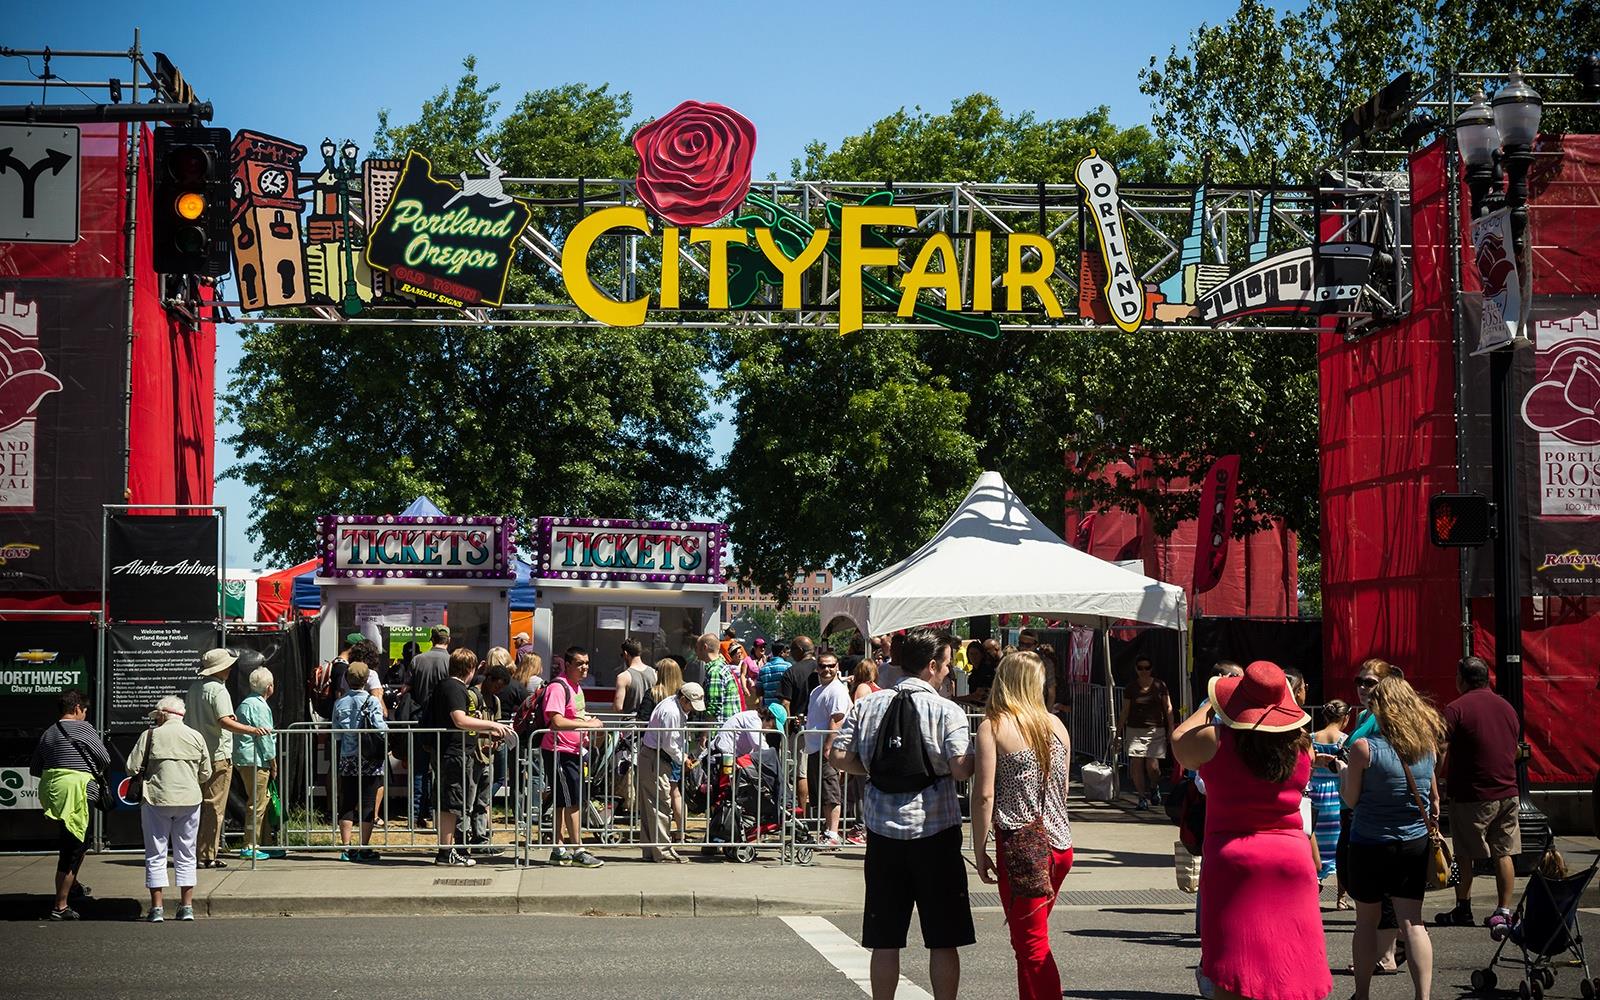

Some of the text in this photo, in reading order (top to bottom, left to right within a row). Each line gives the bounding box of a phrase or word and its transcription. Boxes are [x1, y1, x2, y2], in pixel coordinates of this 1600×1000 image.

[391, 199, 515, 237] Portland
[1090, 163, 1138, 317] PORTLAND
[404, 233, 498, 275] Oregon
[394, 266, 478, 302] OLD TOWN
[400, 283, 463, 309] RAMSAY SIGNS
[1544, 452, 1600, 462] PORTL
[0, 547, 32, 559] IGNS
[341, 528, 490, 566] TICKETS
[556, 531, 702, 571] TICKETS
[1543, 553, 1595, 566] RAMSAY
[112, 559, 215, 576] Alaska Airlines
[11, 685, 62, 694] Chevy Dealers
[20, 787, 38, 797] swi
